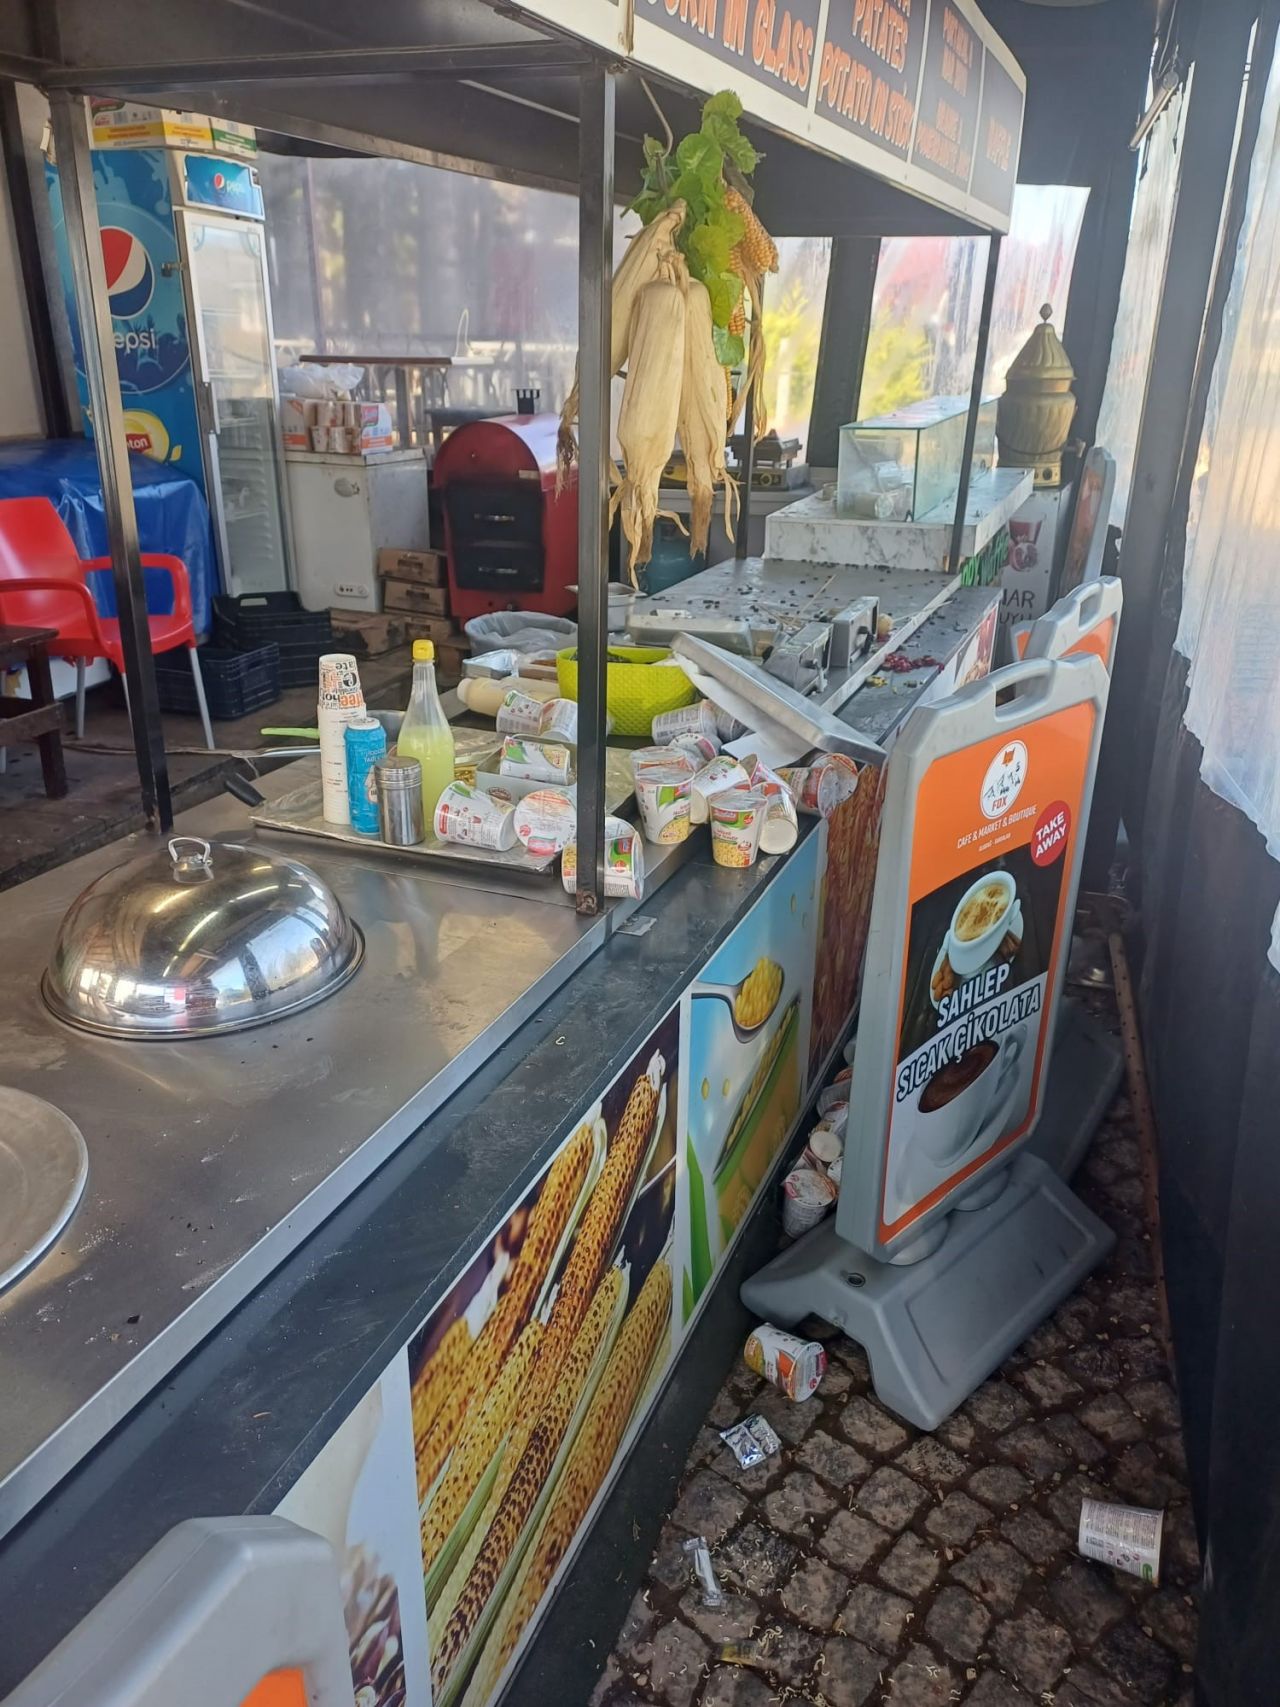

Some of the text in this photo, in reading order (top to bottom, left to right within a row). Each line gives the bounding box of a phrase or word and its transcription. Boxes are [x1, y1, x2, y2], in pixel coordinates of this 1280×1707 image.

[723, 0, 749, 56] IN
[752, 0, 814, 92] GLASS
[851, 0, 908, 74] PATATES
[816, 41, 873, 126] POTATO
[869, 77, 890, 136] ON
[114, 328, 156, 354] epsi
[127, 438, 149, 450] ton
[992, 796, 1008, 811] FOX
[957, 832, 973, 849] CAFE
[978, 820, 1003, 838] MARKET
[1036, 811, 1065, 841] TAKE
[1036, 823, 1067, 858] AWAY
[936, 962, 1010, 1028] SAHLEP
[896, 983, 1041, 1102] SICAK ÇİKOLATA
